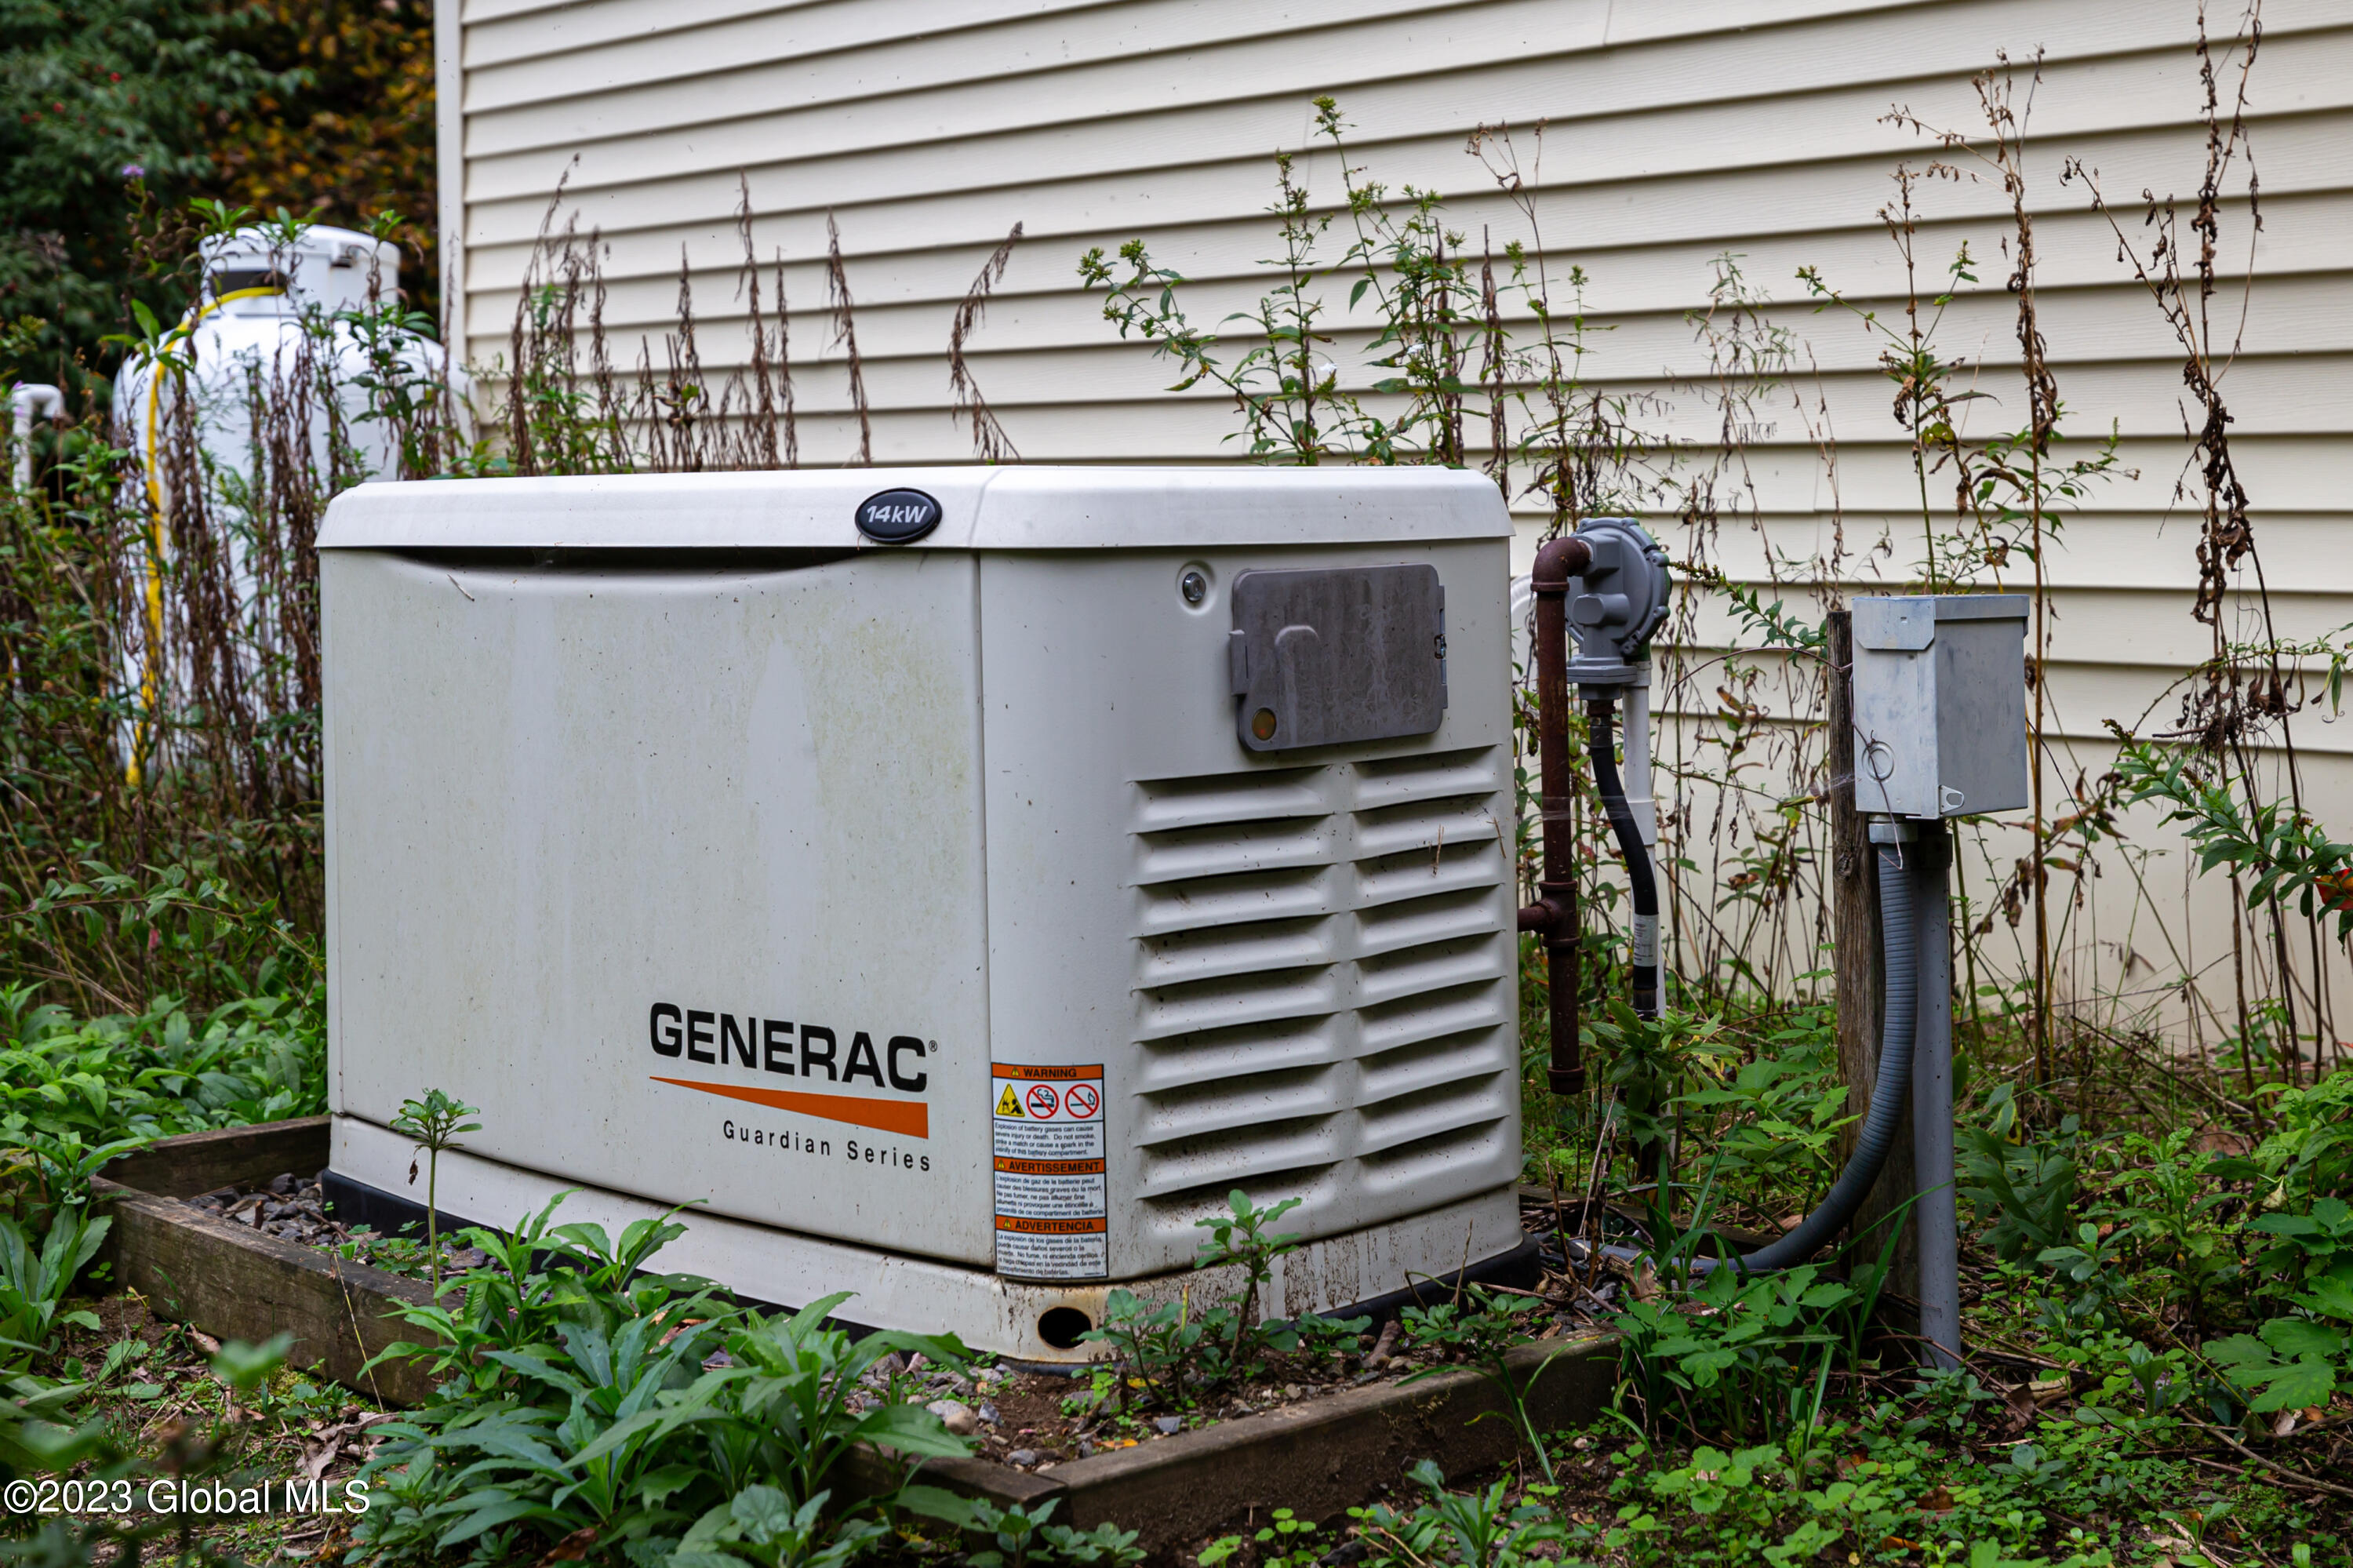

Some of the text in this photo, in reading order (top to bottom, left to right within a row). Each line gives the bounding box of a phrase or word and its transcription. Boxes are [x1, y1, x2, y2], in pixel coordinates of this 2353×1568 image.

[867, 505, 928, 523] 14kW
[1024, 1068, 1077, 1077] WARNING
[723, 1120, 930, 1172] Guardian Series
[1060, 1141, 1076, 1149] spark
[1009, 1161, 1100, 1173] AVERTISSEMENT
[1016, 1221, 1093, 1231] ADVERTENCIA
